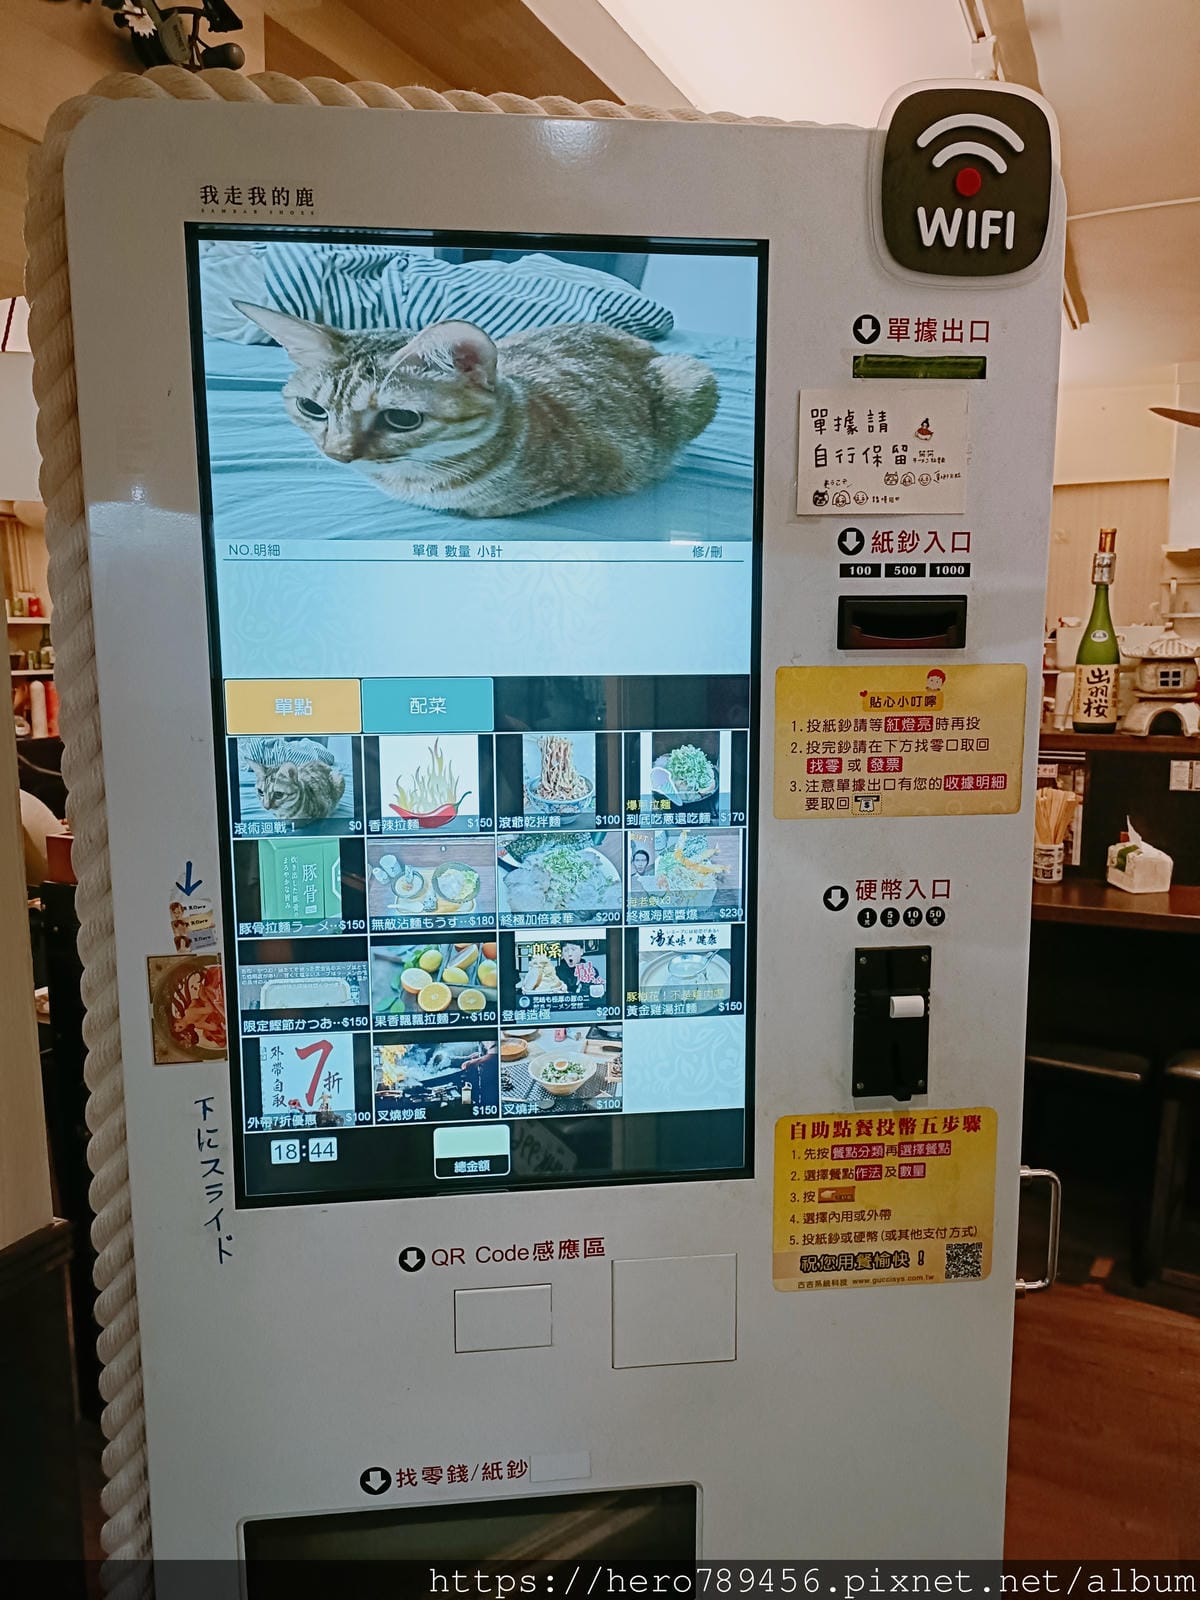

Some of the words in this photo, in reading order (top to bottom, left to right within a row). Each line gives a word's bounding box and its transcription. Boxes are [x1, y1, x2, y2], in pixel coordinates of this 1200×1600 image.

[200, 185, 314, 207] 我走我的鹿
[917, 206, 1015, 250] WIFI
[887, 317, 990, 343] 單據出口
[811, 408, 888, 435] 單據請
[814, 444, 908, 468] 自行保留
[871, 530, 971, 554] 紙鈔入口
[228, 544, 281, 557] NO.明細
[412, 545, 439, 558] 單價
[445, 545, 471, 558] 數量
[477, 545, 503, 558] 小計
[692, 545, 722, 559] 修/刪
[849, 566, 872, 576] 100
[894, 566, 917, 576] 500
[935, 565, 965, 575] 1000
[274, 698, 313, 717] 單點
[409, 697, 447, 715] 配菜
[869, 695, 937, 709] 貼心小叮嚀
[804, 797, 850, 811] 要取回
[595, 815, 620, 826] $100
[720, 812, 745, 823] $170
[348, 821, 363, 831] $0
[368, 819, 420, 832] 香辣拉麵
[467, 818, 493, 829] $150
[302, 863, 318, 905] 豚骨
[855, 879, 951, 901] 硬幣入口
[596, 911, 620, 923] $200
[720, 908, 743, 919] $230
[339, 920, 365, 931] $150
[468, 915, 494, 927] $180
[596, 1006, 621, 1017] $200
[719, 1001, 743, 1012] $150
[342, 1016, 369, 1028] $150
[470, 1011, 496, 1022] $150
[472, 1105, 497, 1116] $150
[596, 1099, 621, 1110] $100
[345, 1111, 371, 1122] $100
[790, 1115, 982, 1140] 自助點餐投幣五步驟
[273, 1140, 335, 1161] 18:44
[194, 1097, 233, 1265] 下にスライド
[431, 1248, 466, 1267] QR
[396, 1459, 529, 1489] 找零錢/紙鈔
